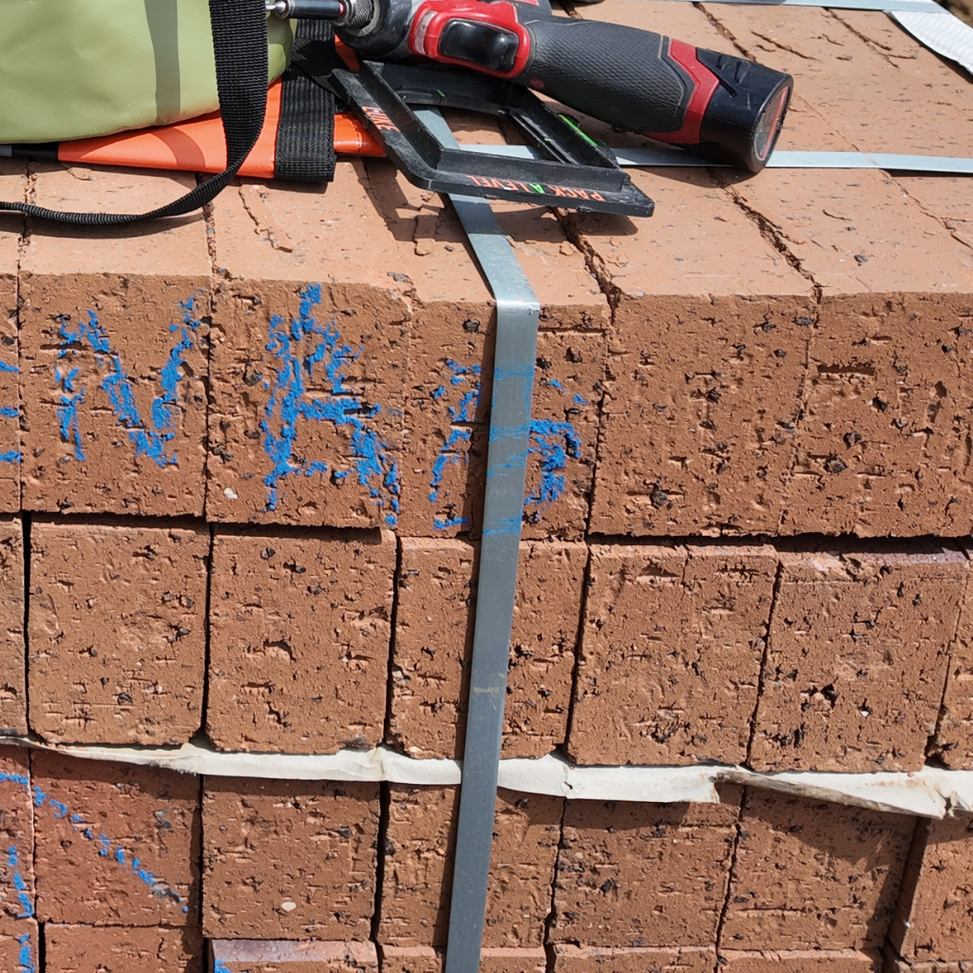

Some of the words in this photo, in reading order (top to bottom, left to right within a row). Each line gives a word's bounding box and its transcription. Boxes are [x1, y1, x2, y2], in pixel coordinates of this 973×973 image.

[466, 174, 531, 193] LEVEL
[529, 182, 545, 194] A
[547, 184, 605, 202] PACK
